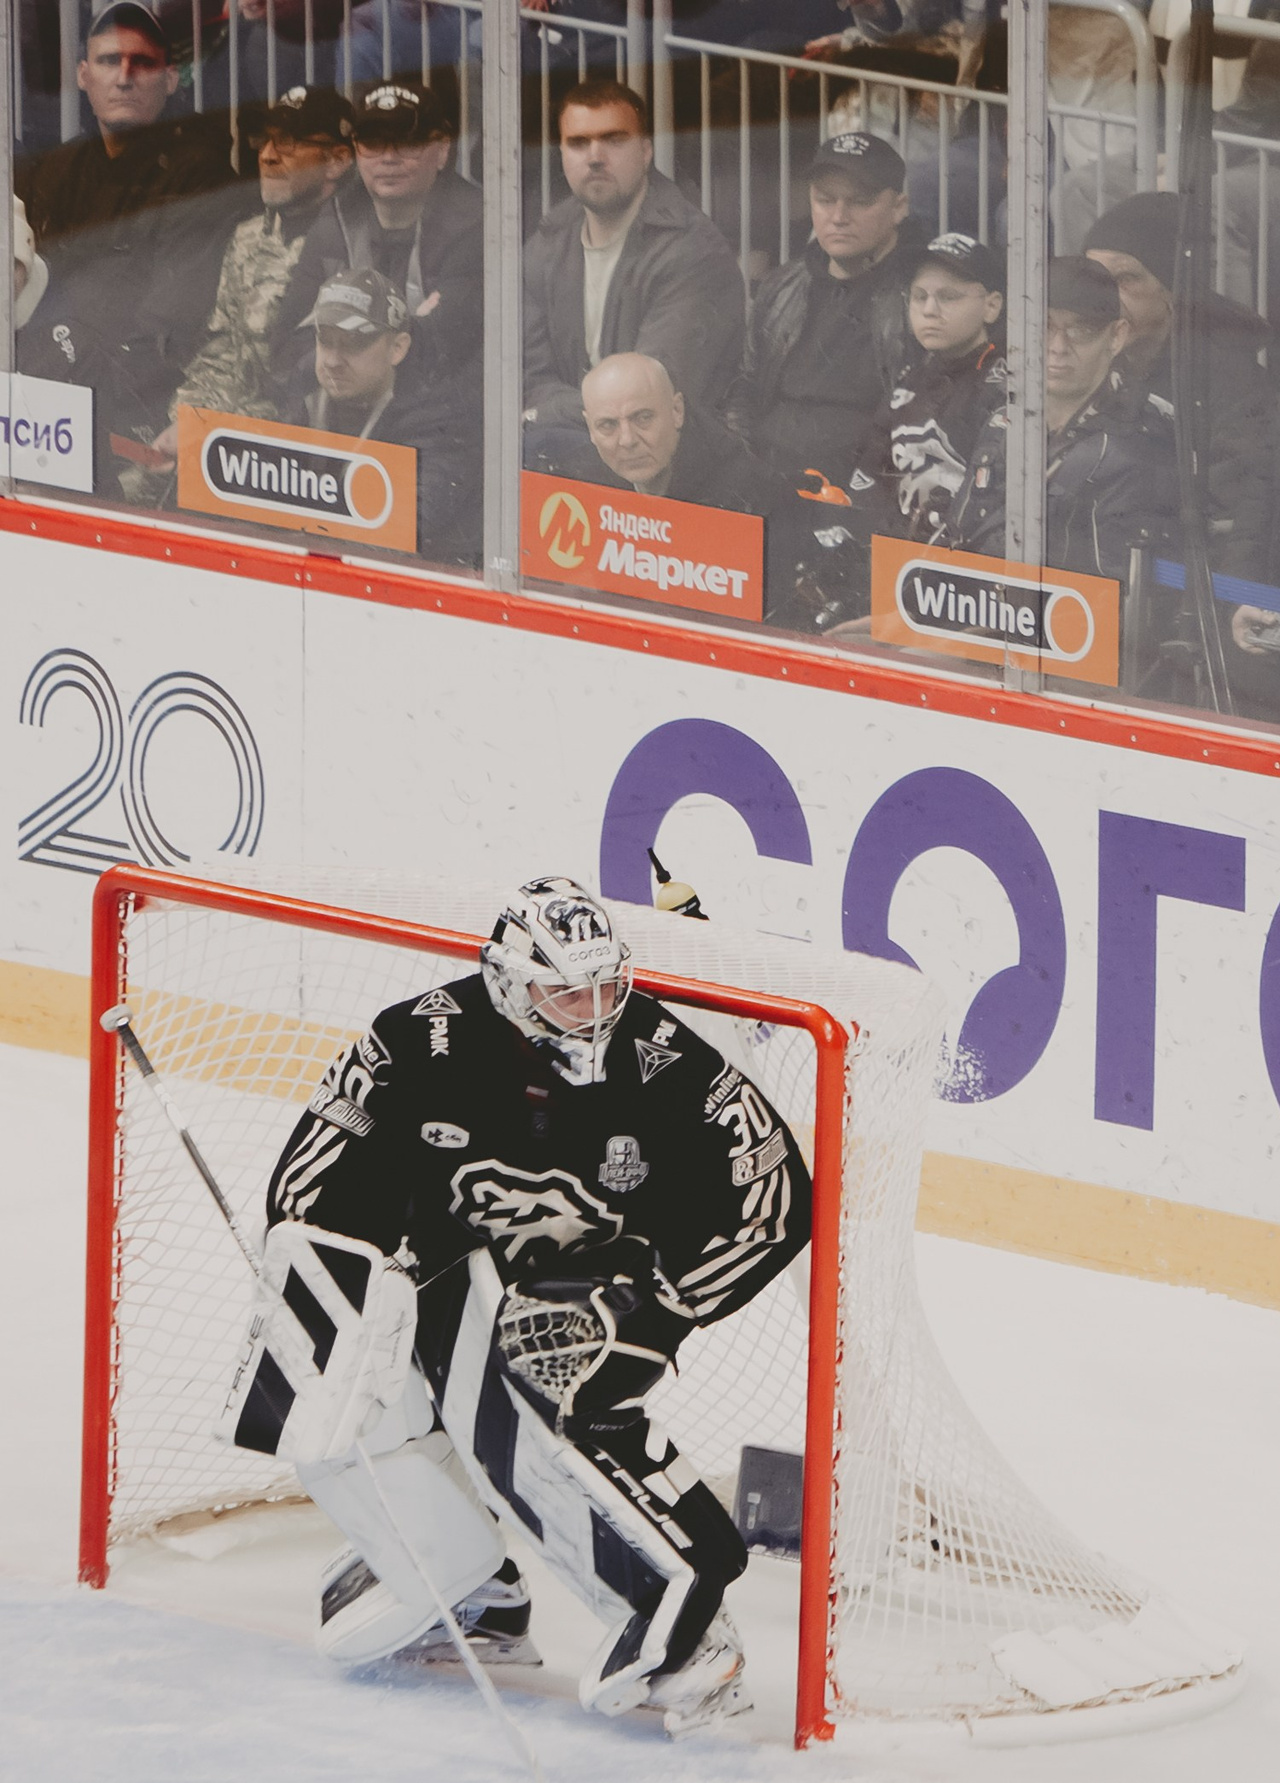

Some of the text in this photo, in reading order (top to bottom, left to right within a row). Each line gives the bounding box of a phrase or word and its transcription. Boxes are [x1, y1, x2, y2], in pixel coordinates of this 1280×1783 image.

[218, 445, 338, 504] Winline
[599, 505, 671, 543] Яндекс
[597, 539, 749, 599] Маркет
[914, 577, 1036, 637] Winline
[18, 648, 265, 876] 20
[568, 945, 611, 962] согаз
[717, 1083, 773, 1158] 30
